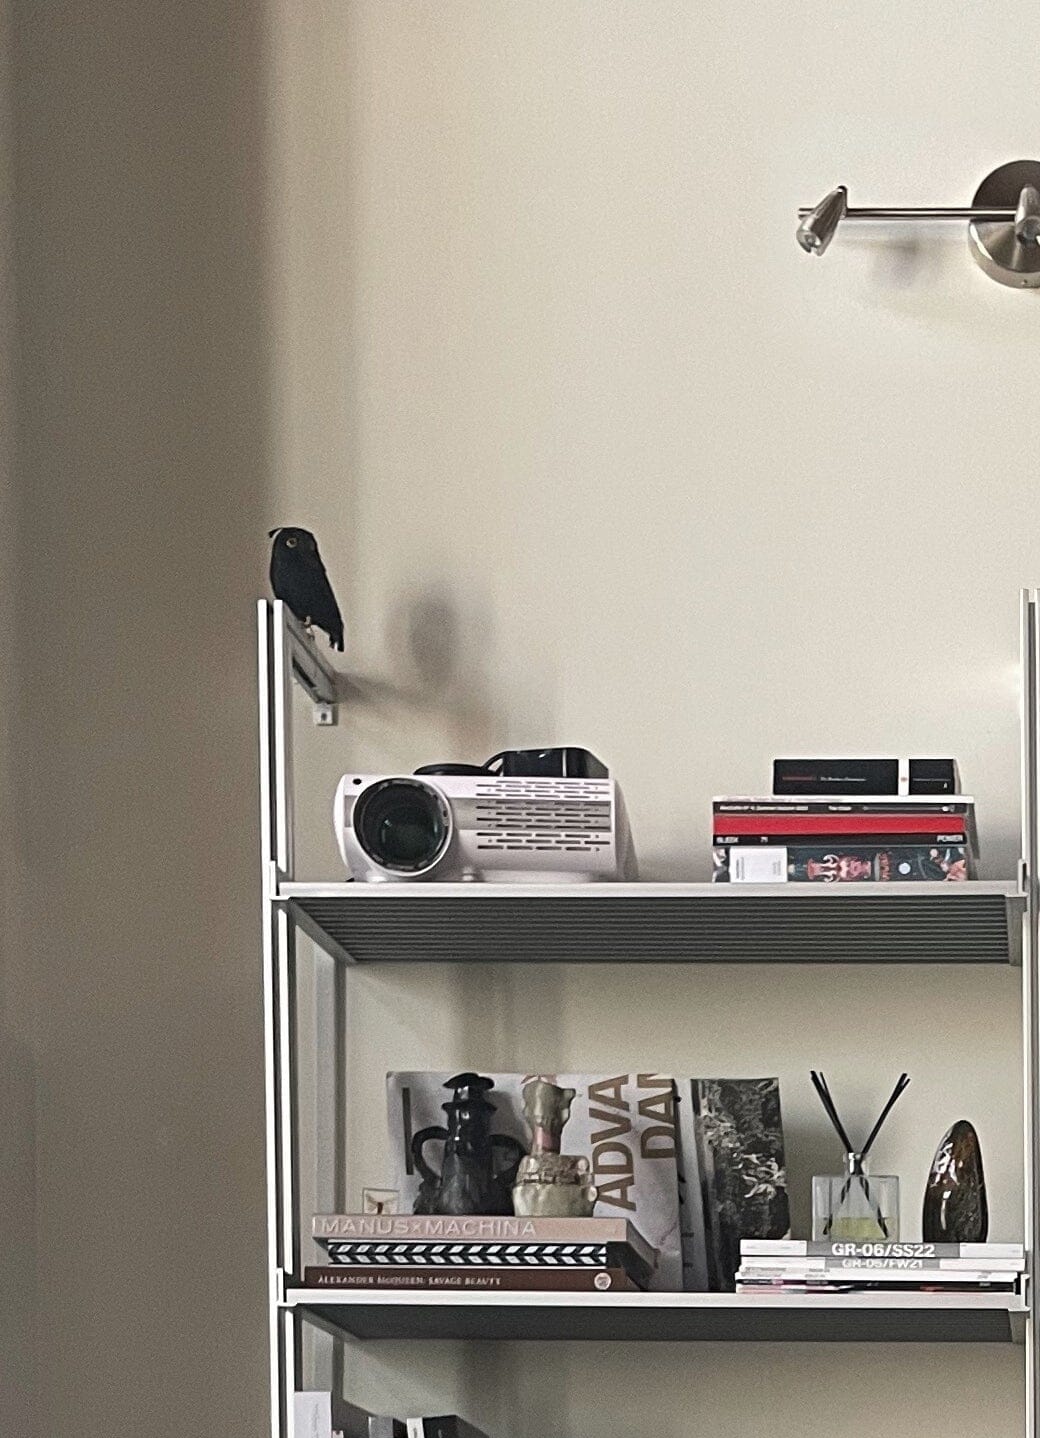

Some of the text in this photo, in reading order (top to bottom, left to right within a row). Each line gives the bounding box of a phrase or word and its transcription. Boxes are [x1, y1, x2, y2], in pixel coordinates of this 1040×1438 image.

[425, 1219, 537, 1236] MACHINA
[832, 1243, 936, 1258] GR-06/SS22
[842, 1258, 923, 1269] GR-05/FW21
[318, 1274, 375, 1285] ALEXANDER
[428, 1276, 462, 1286] SAVAGE
[464, 1277, 502, 1286] BEAUTY
